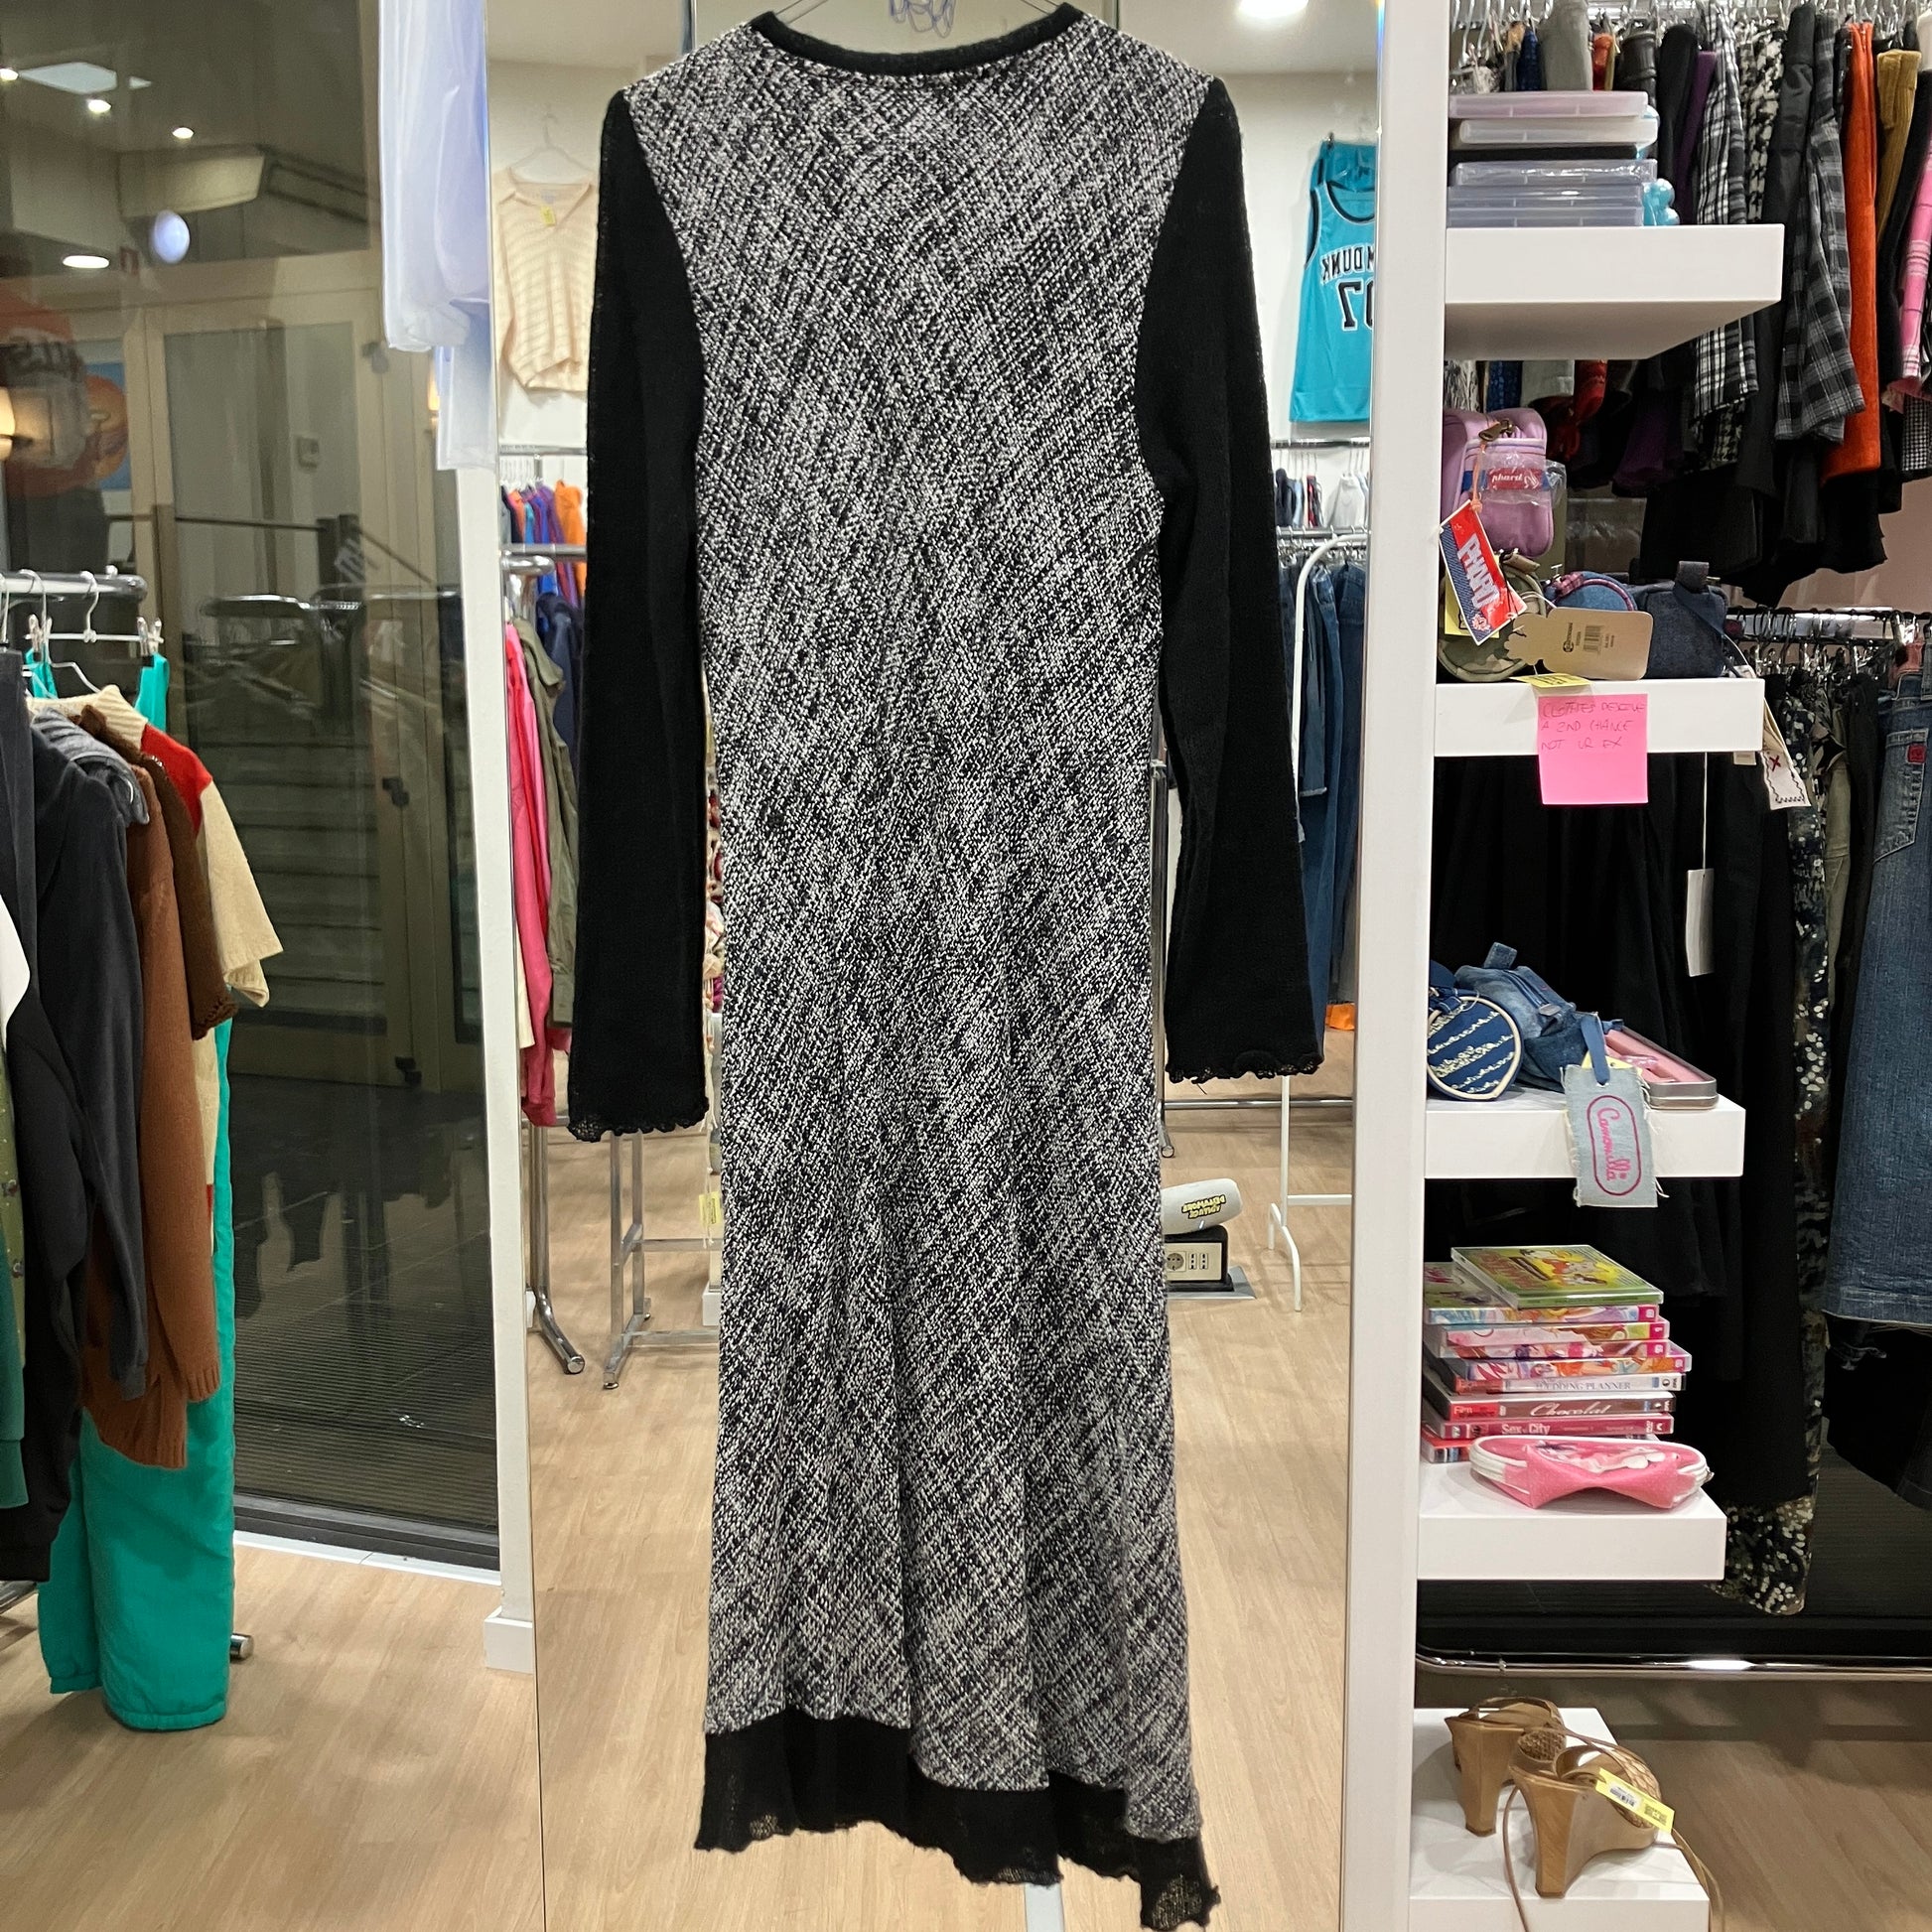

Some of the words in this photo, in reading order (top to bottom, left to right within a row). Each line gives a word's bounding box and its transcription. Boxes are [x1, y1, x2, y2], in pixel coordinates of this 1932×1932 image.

[1491, 475, 1523, 484] phard
[1456, 532, 1500, 610] PHARD
[1541, 720, 1550, 731] A
[1557, 720, 1581, 733] 2ND
[1589, 718, 1634, 733] CHANCE
[1541, 739, 1566, 751] NOT
[1586, 1379, 1631, 1391] PLANNER
[1530, 1401, 1611, 1417] Chocolat
[1502, 1423, 1522, 1435] Sex
[1529, 1423, 1551, 1436] City
